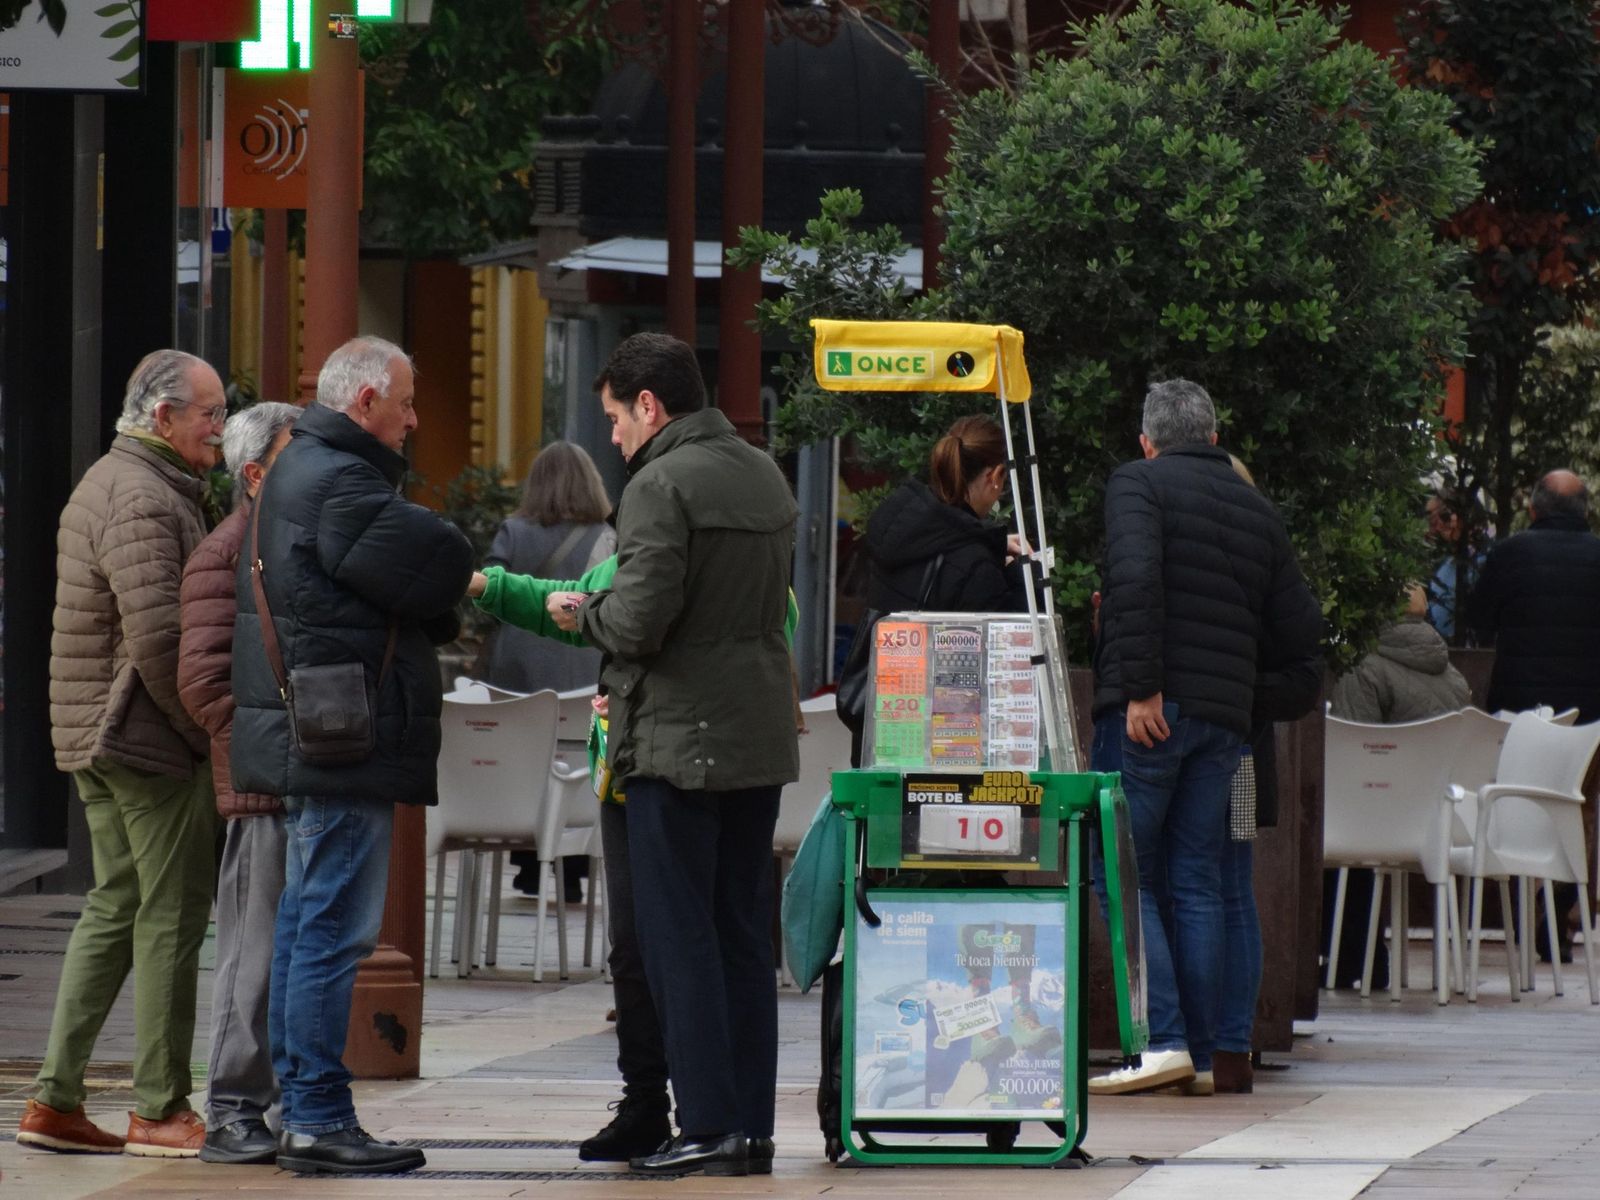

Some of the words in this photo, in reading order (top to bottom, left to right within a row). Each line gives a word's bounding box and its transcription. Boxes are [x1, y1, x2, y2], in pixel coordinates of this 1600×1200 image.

[857, 356, 926, 374] ONCE
[983, 771, 1022, 787] EURO
[907, 792, 943, 803] BOTE
[945, 792, 963, 803] DE
[968, 786, 1037, 803] JACKPOT
[968, 954, 991, 967] toca
